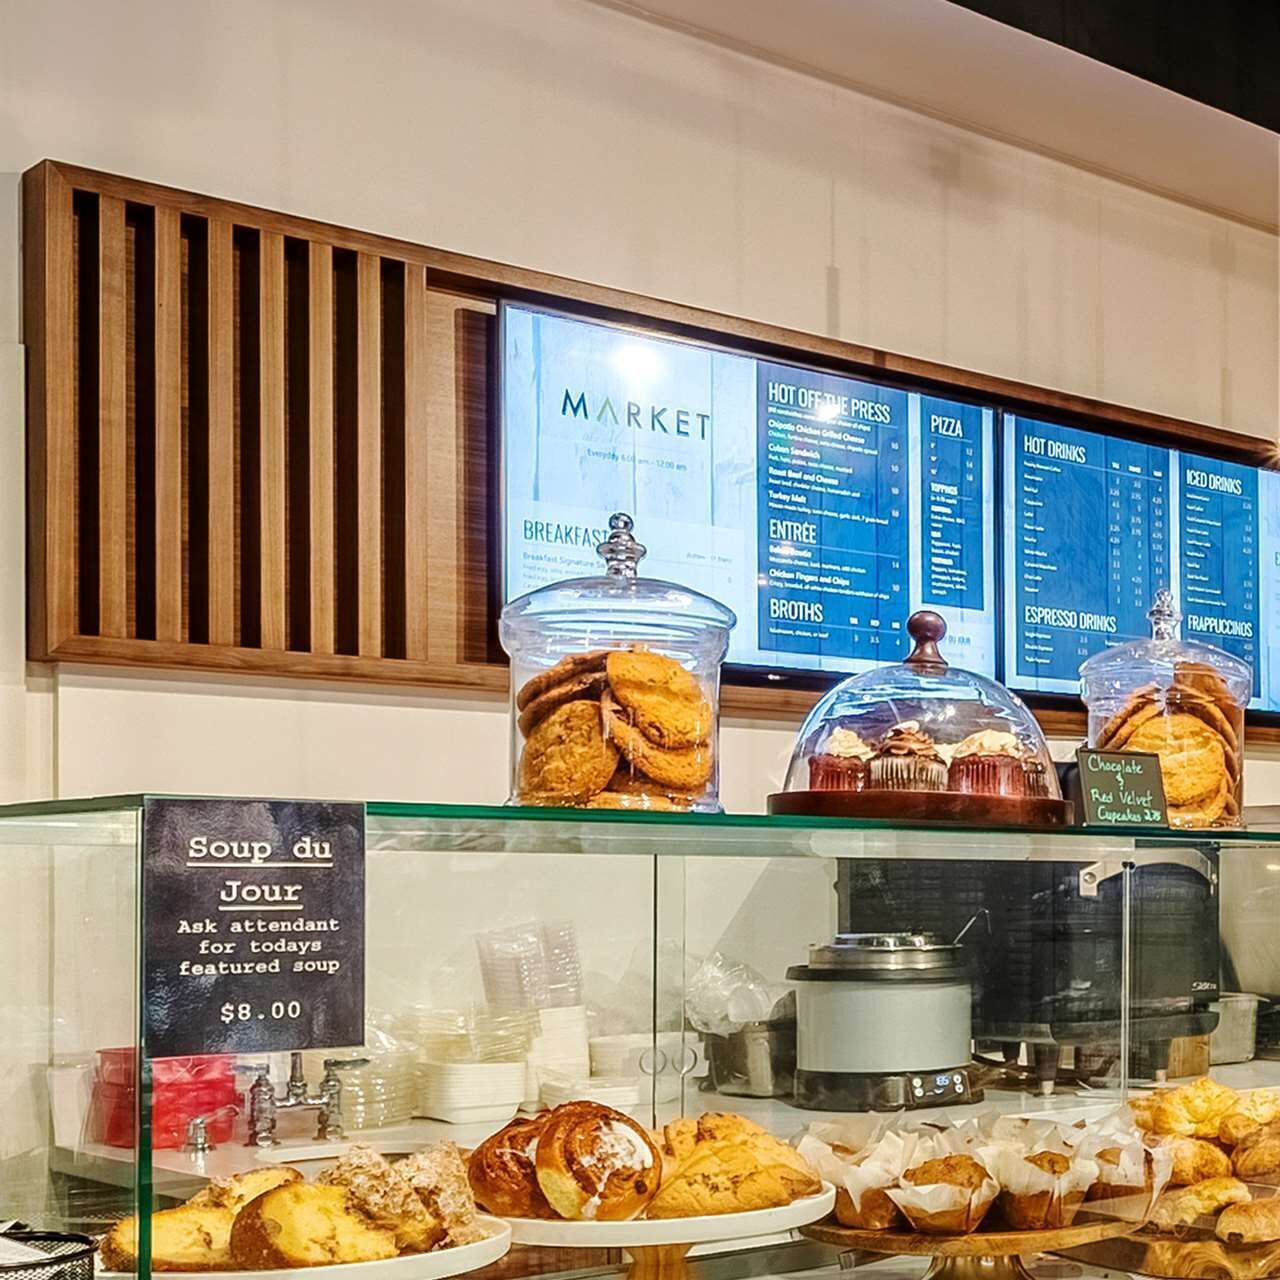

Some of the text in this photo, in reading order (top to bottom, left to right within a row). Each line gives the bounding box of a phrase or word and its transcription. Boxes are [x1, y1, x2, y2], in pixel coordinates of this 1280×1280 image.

[768, 382, 796, 405] HOT
[798, 388, 822, 409] OFF
[823, 393, 849, 416] THE
[851, 398, 891, 423] PRESS
[561, 388, 710, 441] MARKET
[931, 415, 963, 438] PIZZA
[587, 448, 619, 462] Everyday
[1023, 435, 1086, 463] HOT DRINKS
[1186, 469, 1208, 488] ICED
[1209, 473, 1242, 495] DRINKS
[768, 490, 790, 502] Turkey
[523, 519, 609, 548] BREAKFAST
[769, 518, 817, 544] ENTRÉE
[523, 552, 557, 564] Breakfast
[559, 556, 593, 570] Signature
[769, 568, 795, 579] Chicken
[769, 598, 824, 622] BROTHS
[1024, 606, 1117, 633] ESPRESSO DRINKS
[1187, 614, 1253, 638] FRAPPUCCINOS
[1087, 753, 1144, 774] Chocolate
[1090, 788, 1153, 807] Red Velvet
[1097, 805, 1142, 824] Cupcakes
[187, 836, 333, 865] Soup du
[219, 880, 303, 902] Jour
[176, 918, 340, 934] Ask attendant
[198, 938, 322, 955] for todays
[178, 958, 340, 976] featured soup
[219, 1001, 301, 1025] $8.00
